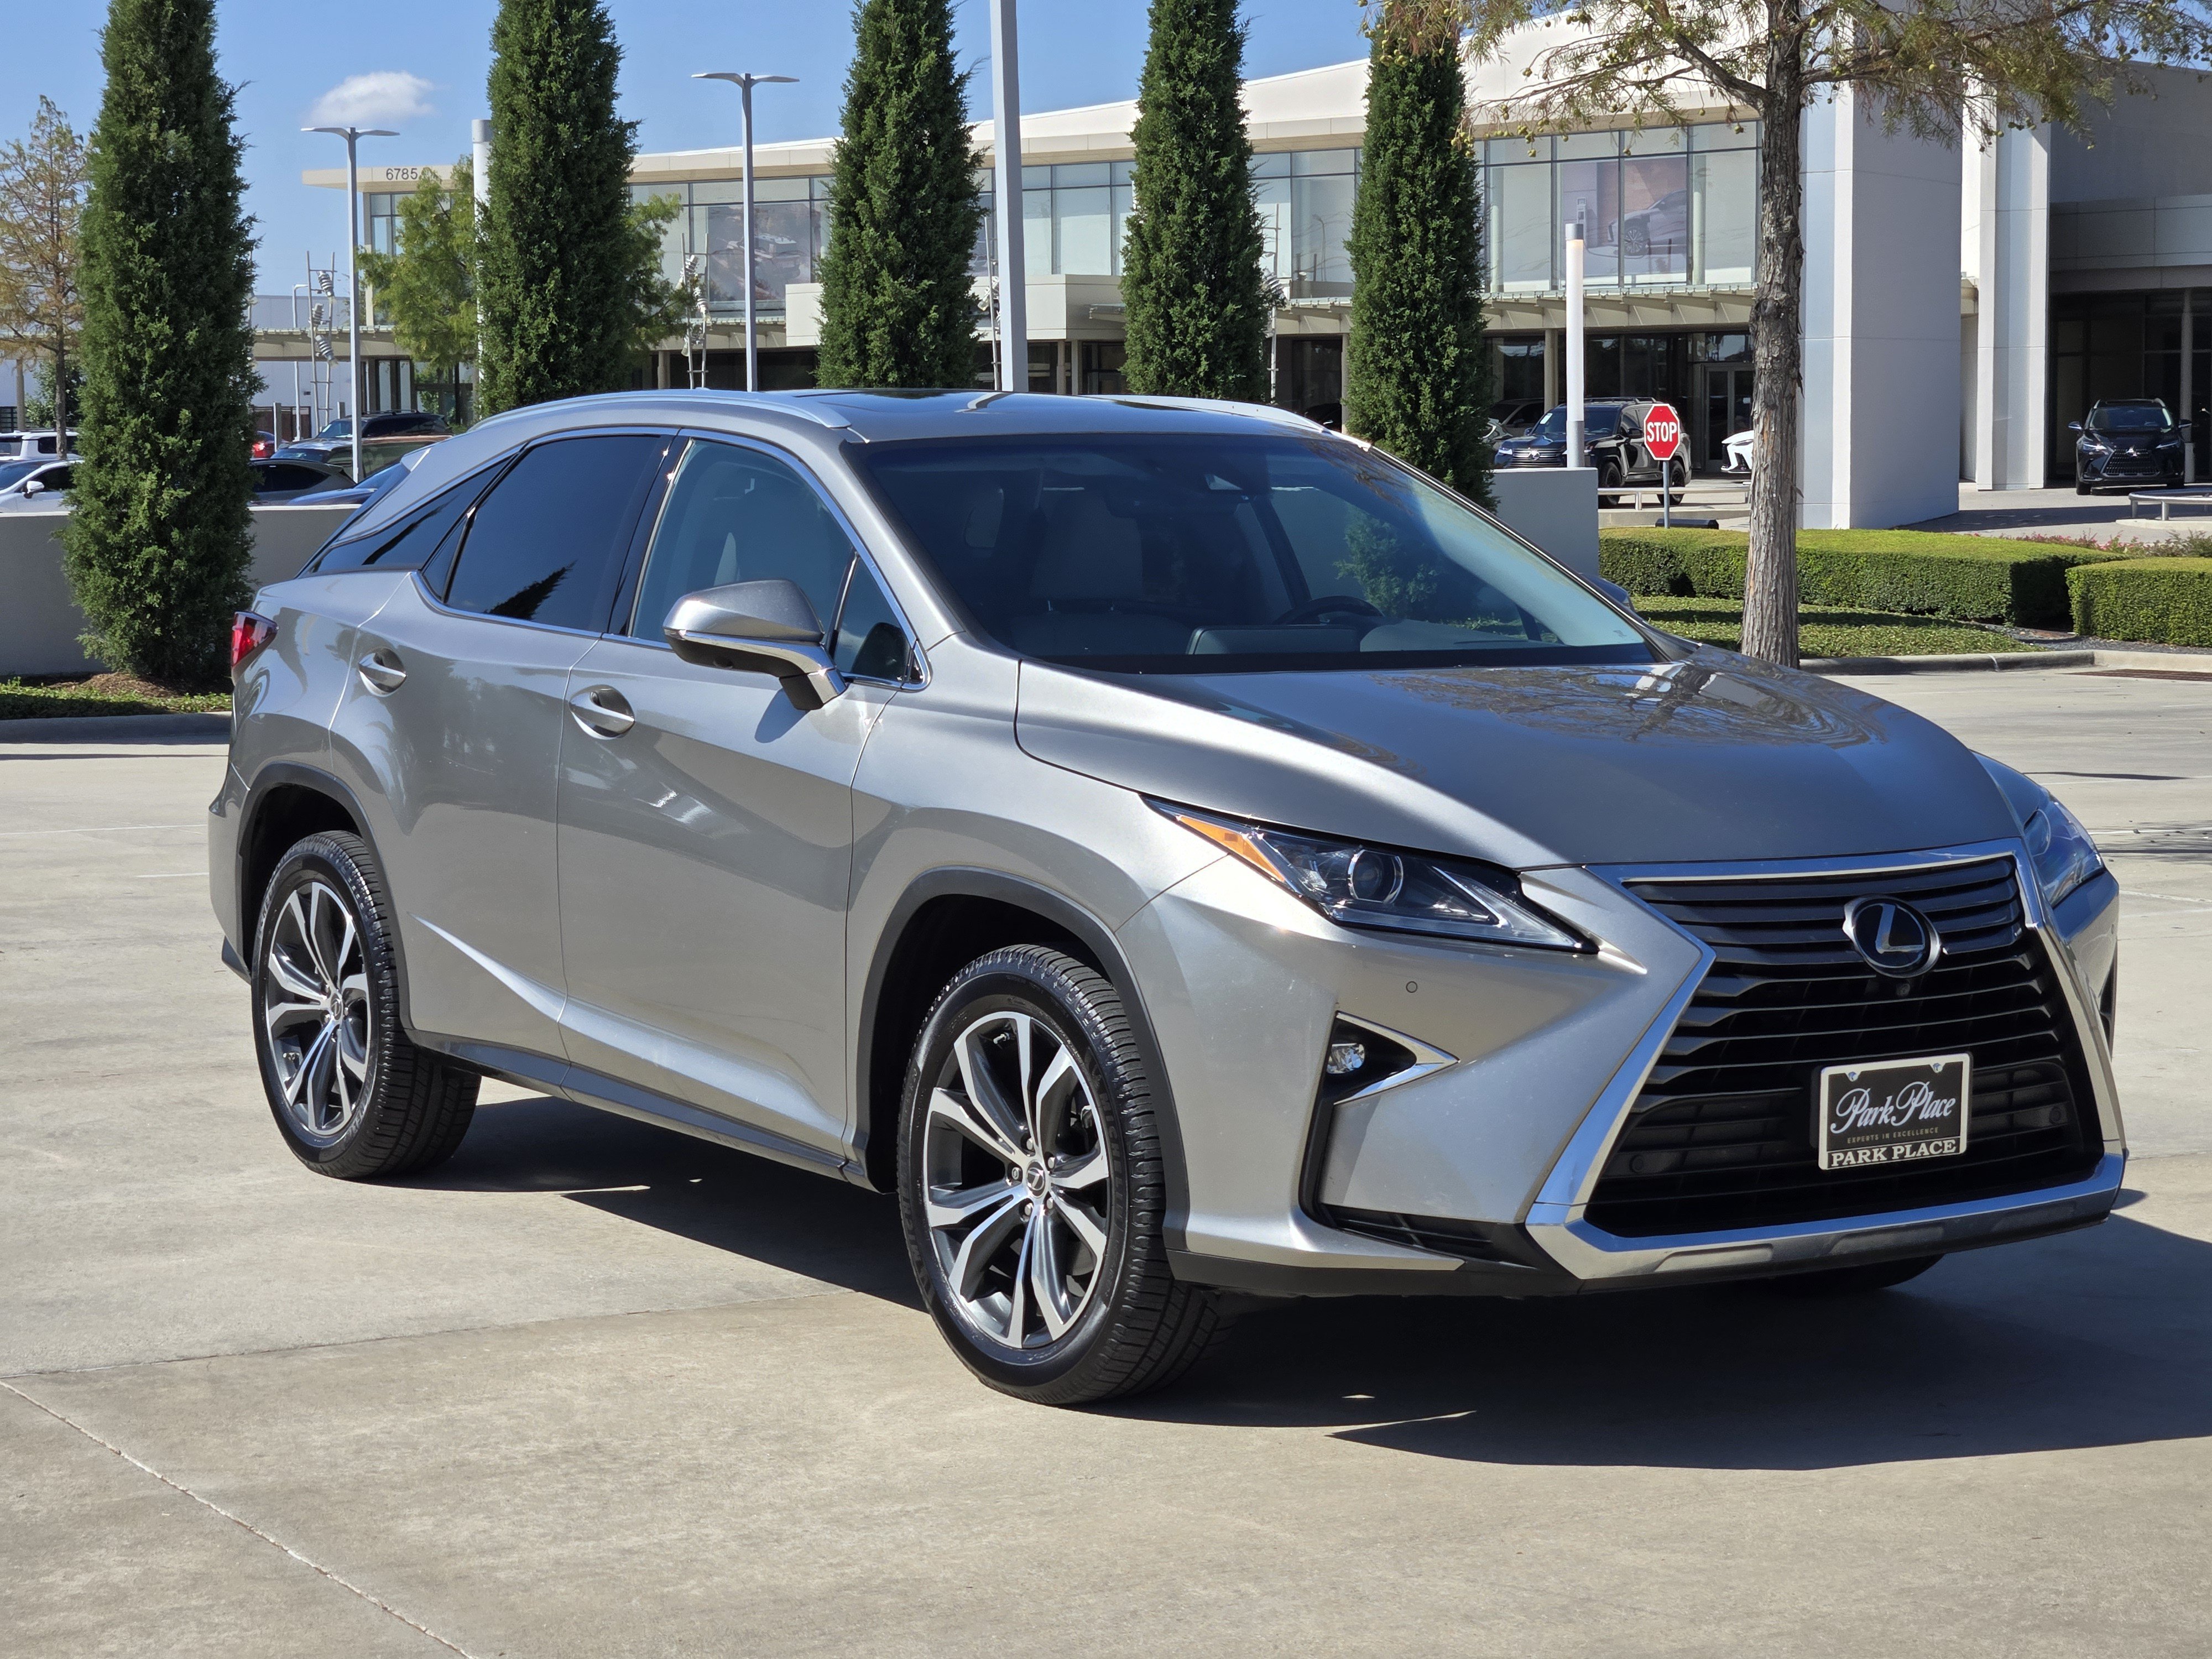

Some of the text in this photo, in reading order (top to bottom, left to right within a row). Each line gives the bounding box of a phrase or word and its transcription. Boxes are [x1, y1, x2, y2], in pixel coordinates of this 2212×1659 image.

[386, 168, 418, 180] 6785
[1647, 421, 1677, 442] STOP
[1830, 1081, 1956, 1134] Park Place
[1847, 1134, 1879, 1144] EXPERTS
[1893, 1126, 1939, 1138] EXCELLENCE
[1831, 1139, 1957, 1167] PARK PLACE
